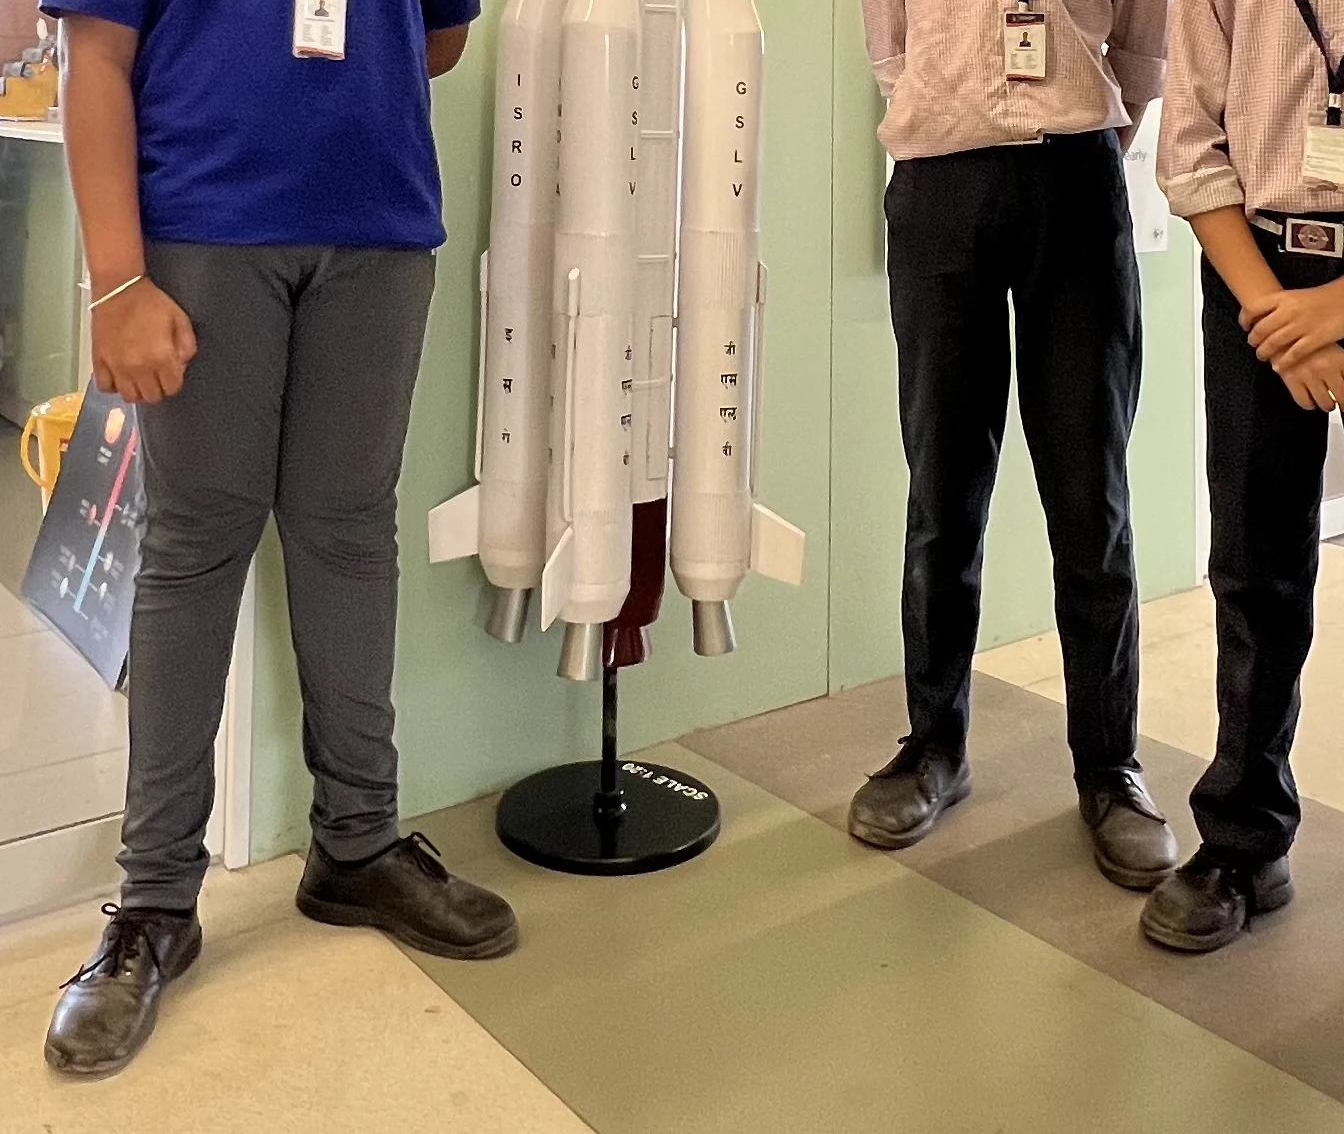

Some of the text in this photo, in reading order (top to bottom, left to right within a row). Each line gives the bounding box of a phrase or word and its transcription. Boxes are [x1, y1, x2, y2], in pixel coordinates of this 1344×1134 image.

[510, 73, 524, 187] ISRO
[628, 75, 640, 196] GSLV
[732, 81, 747, 197] GSLV
[653, 775, 709, 800] SCALE
